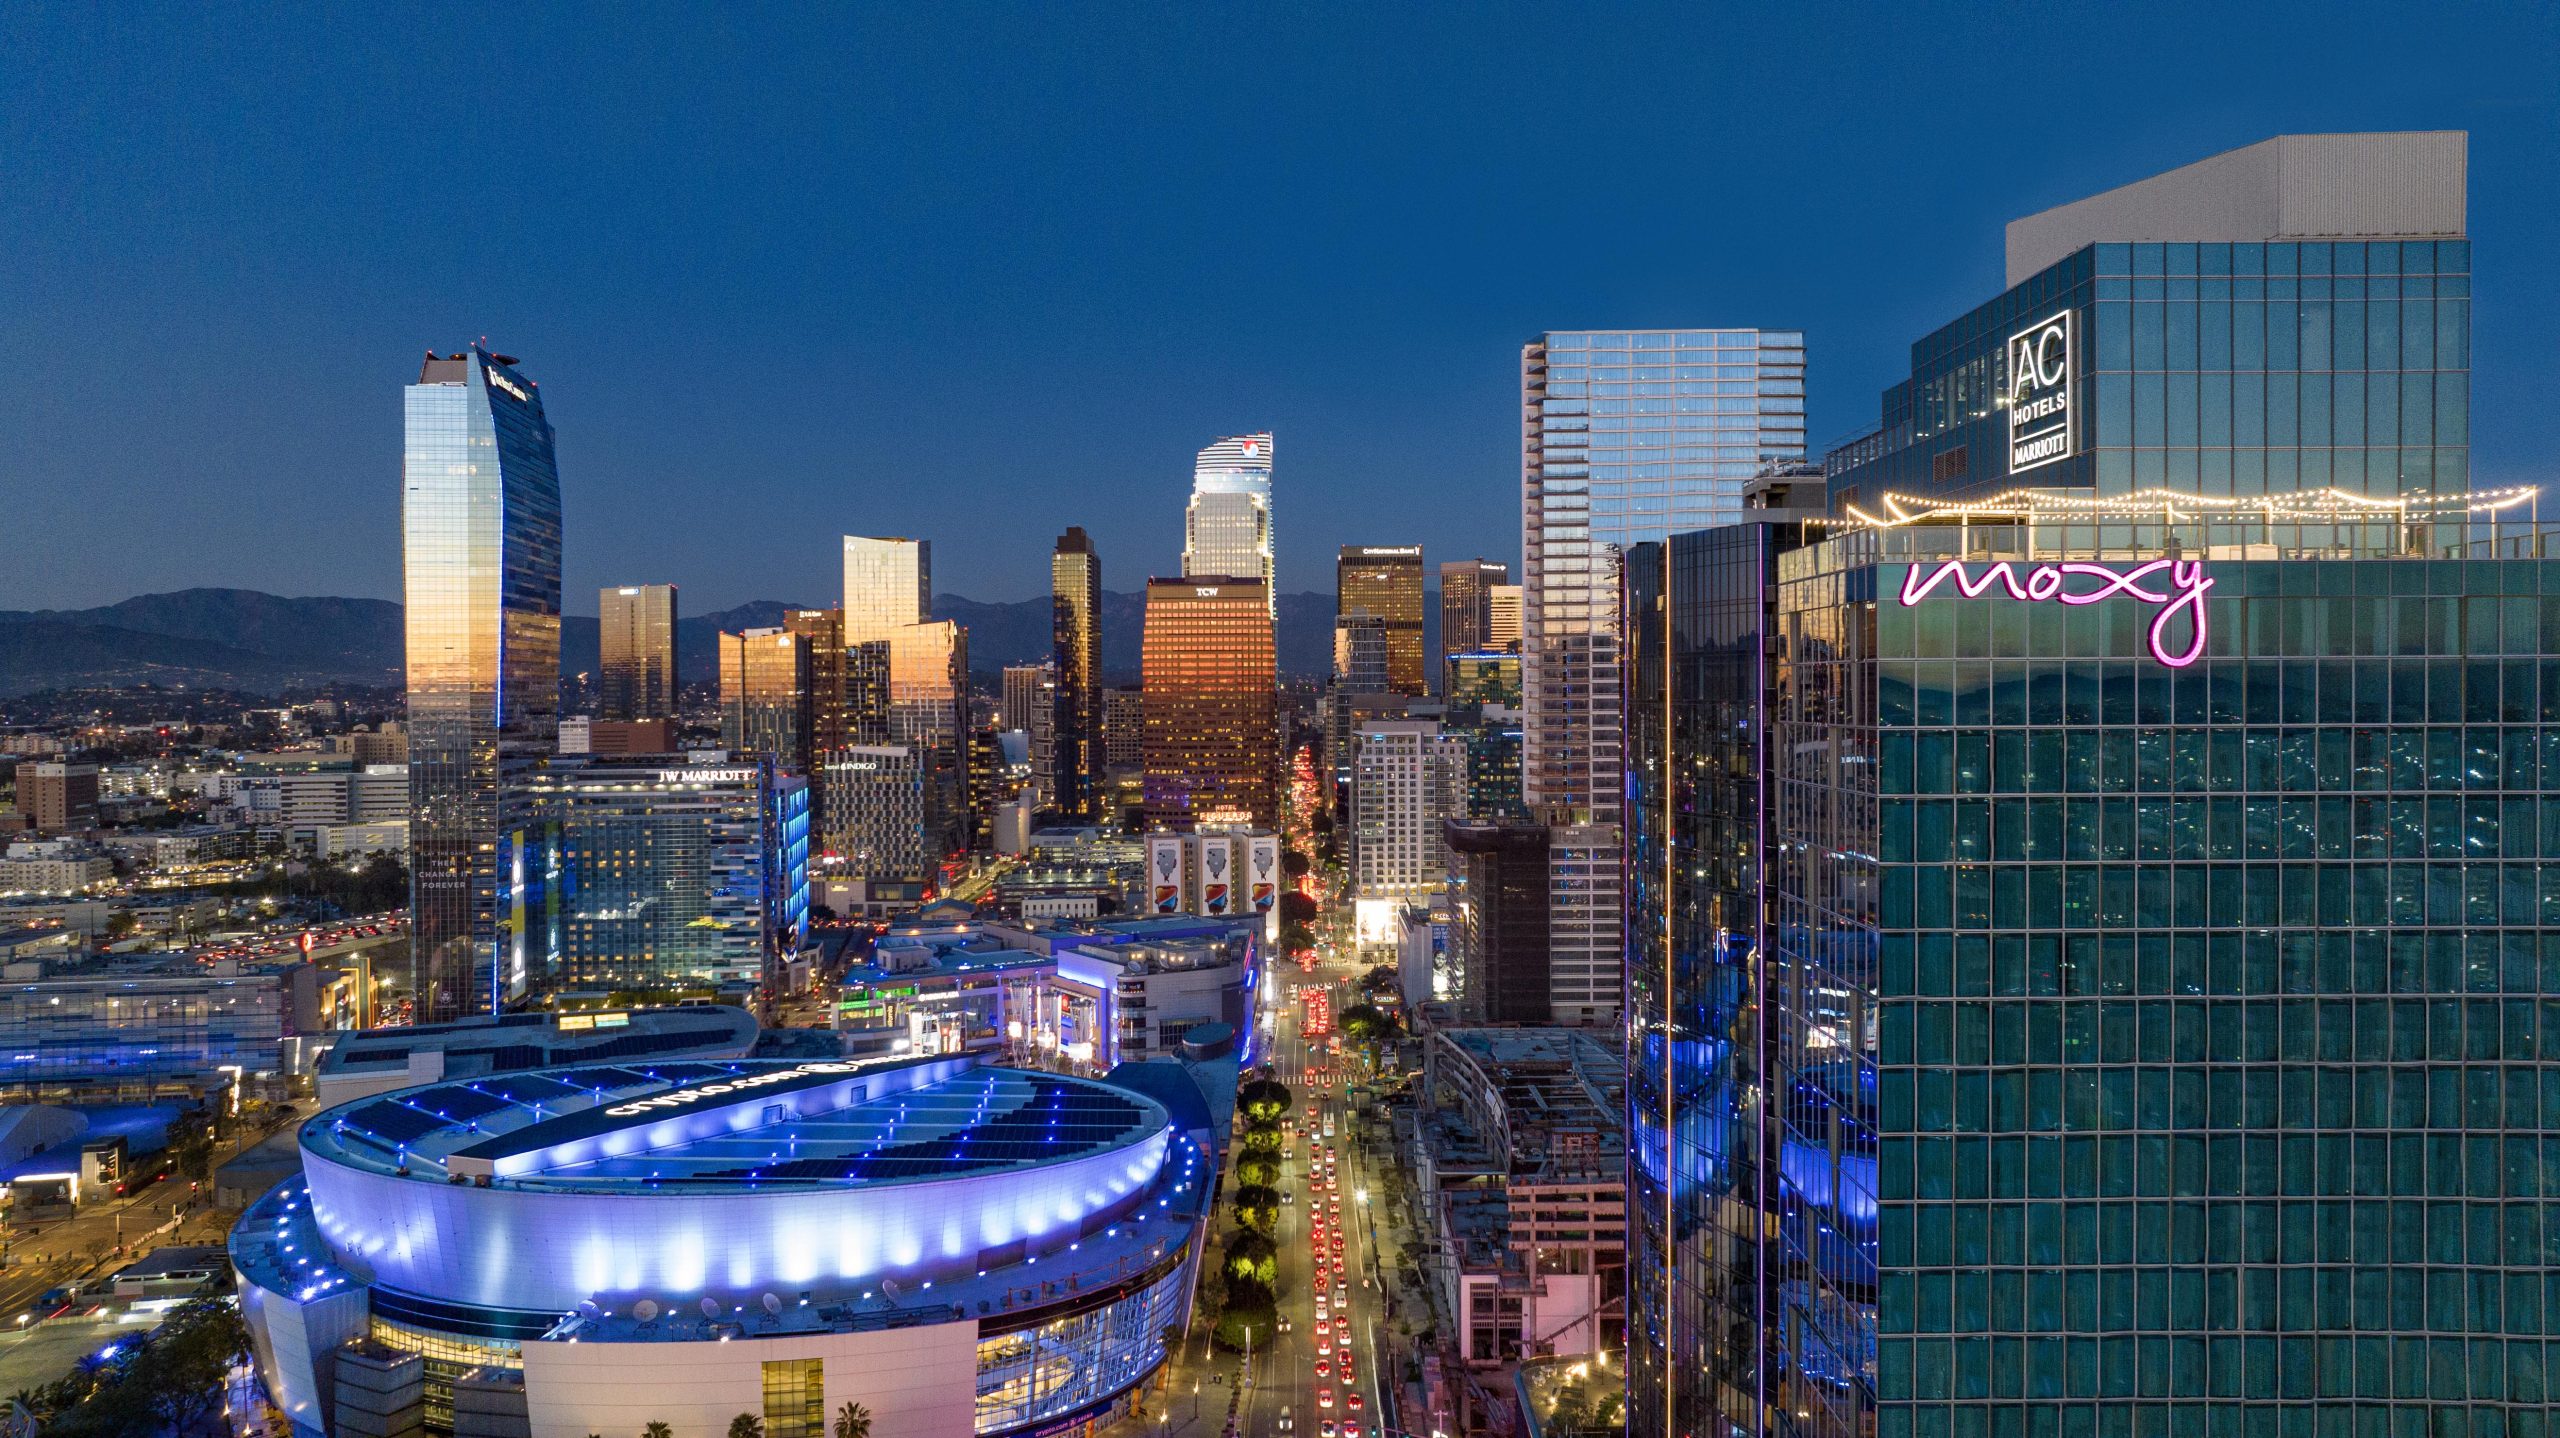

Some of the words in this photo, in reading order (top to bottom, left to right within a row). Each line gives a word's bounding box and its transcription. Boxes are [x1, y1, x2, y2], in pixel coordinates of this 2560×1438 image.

[2015, 325, 2064, 399] AC
[2013, 391, 2066, 426] HOTELS
[2014, 432, 2066, 466] MARRIOTT
[1196, 587, 1219, 597] TCW
[1900, 559, 2215, 669] moxy
[846, 762, 877, 770] INDIGO
[659, 770, 679, 783] JW
[681, 769, 752, 782] MARRIOTT
[1199, 811, 1253, 822] FIGUEROA
[422, 881, 466, 889] FOREVER
[605, 1069, 810, 1117] crypto.com
[1035, 1422, 1069, 1437] crypto.com
